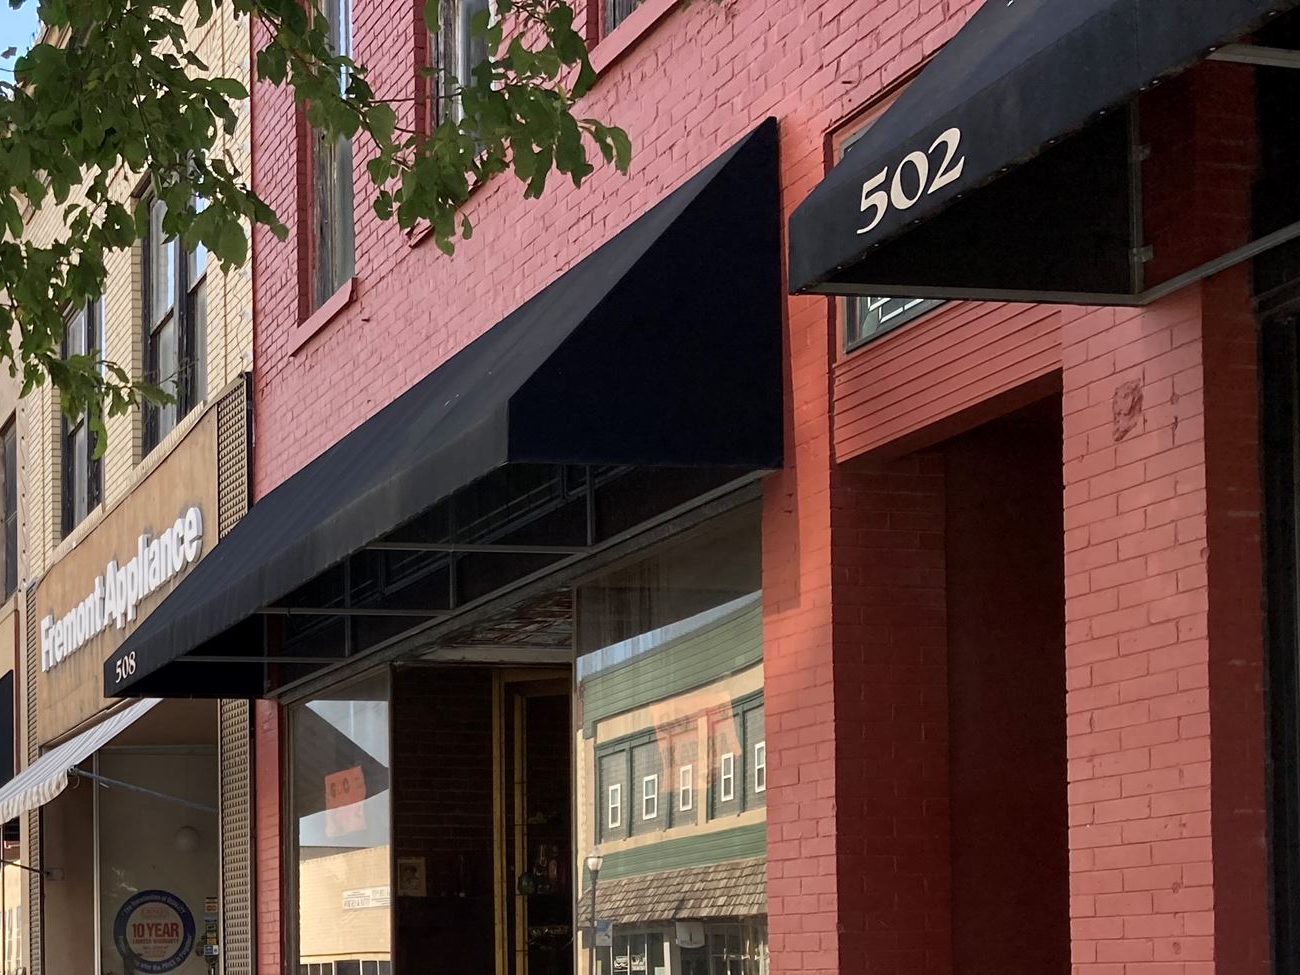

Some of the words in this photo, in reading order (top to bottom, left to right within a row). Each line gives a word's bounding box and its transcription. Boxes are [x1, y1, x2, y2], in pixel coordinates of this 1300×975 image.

[856, 127, 965, 235] 502
[41, 575, 105, 673] Fremont
[103, 506, 203, 630] Appliance
[115, 650, 137, 684] 508
[132, 923, 145, 938] 10
[146, 922, 179, 938] YEAR
